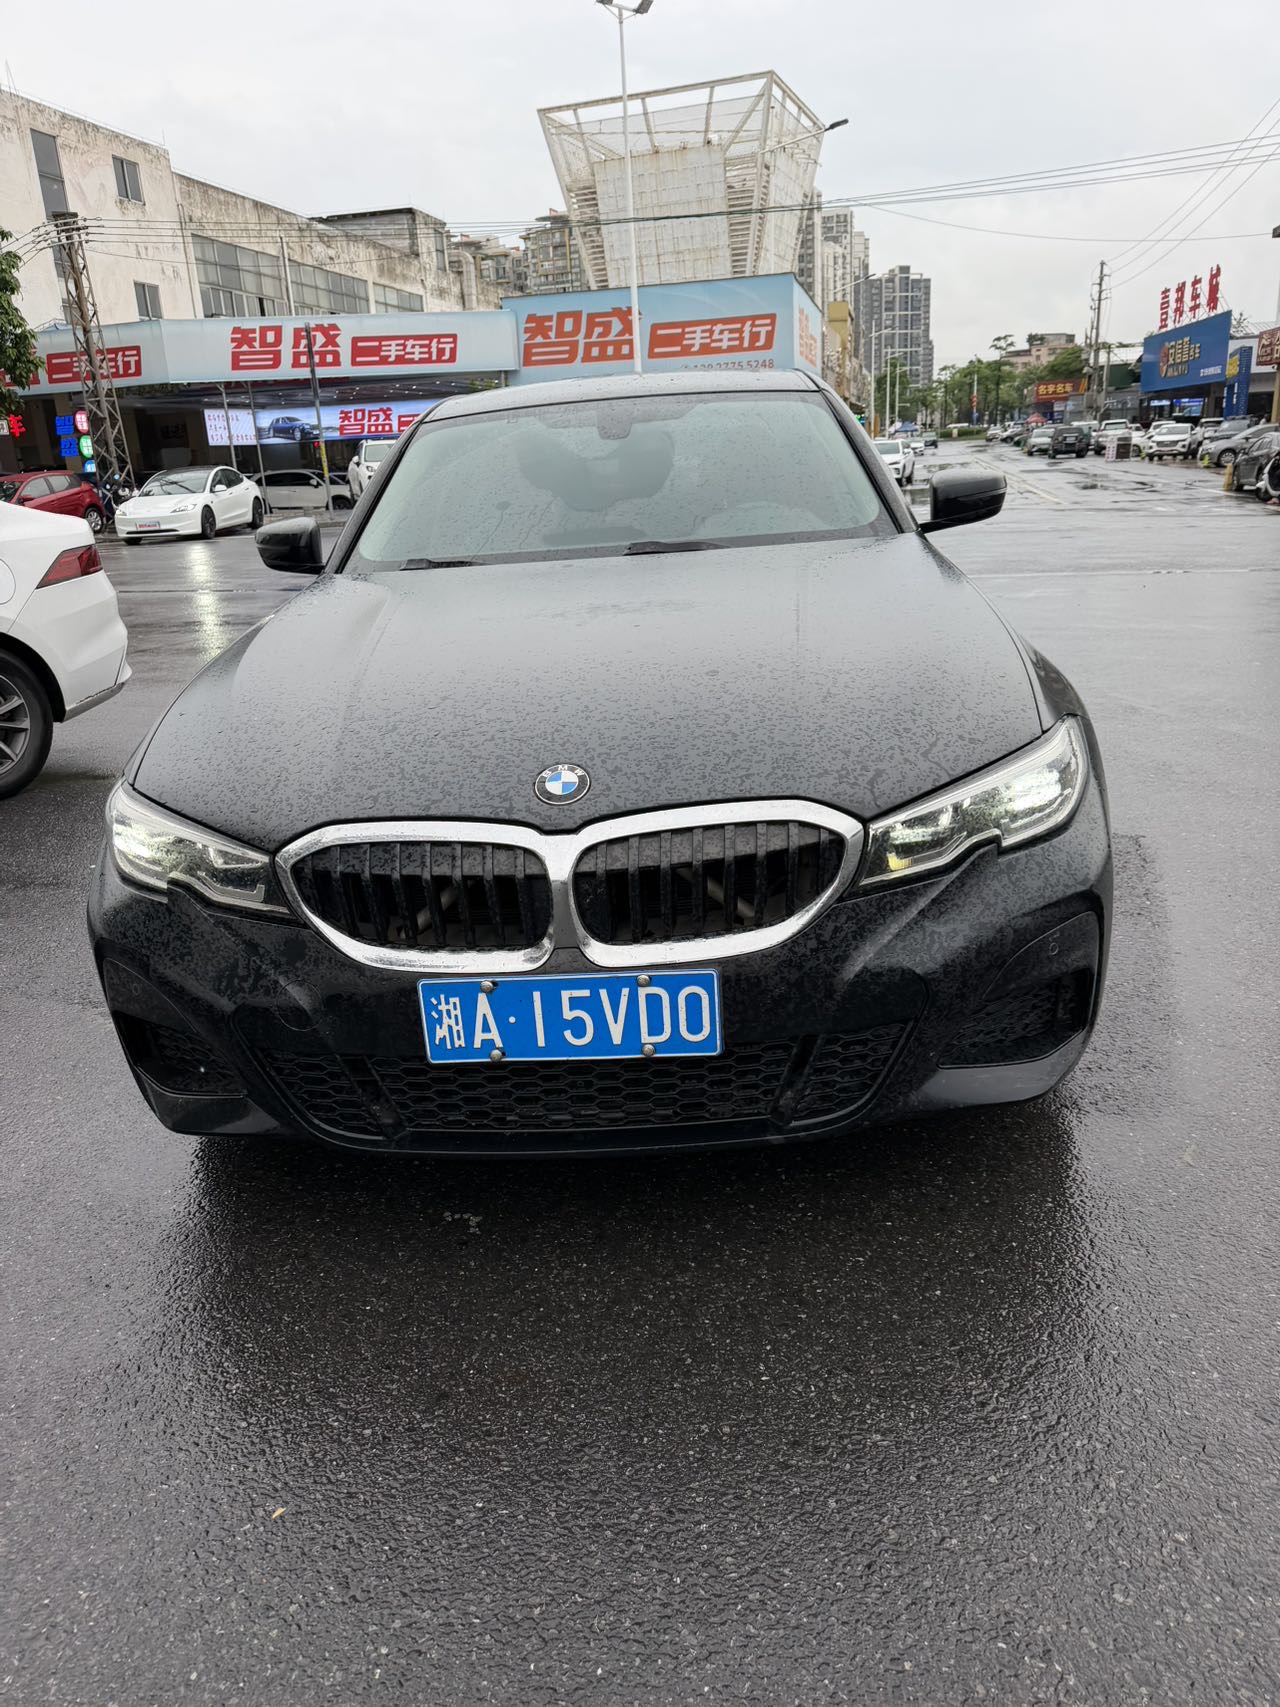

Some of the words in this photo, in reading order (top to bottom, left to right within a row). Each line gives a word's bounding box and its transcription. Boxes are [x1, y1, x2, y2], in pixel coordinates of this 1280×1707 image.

[230, 323, 342, 372] 智盛
[355, 337, 456, 365] 二手车行
[522, 307, 642, 367] 智盛
[653, 319, 773, 354] 二手车行
[339, 406, 394, 436] 智盛
[541, 764, 585, 777] BMW
